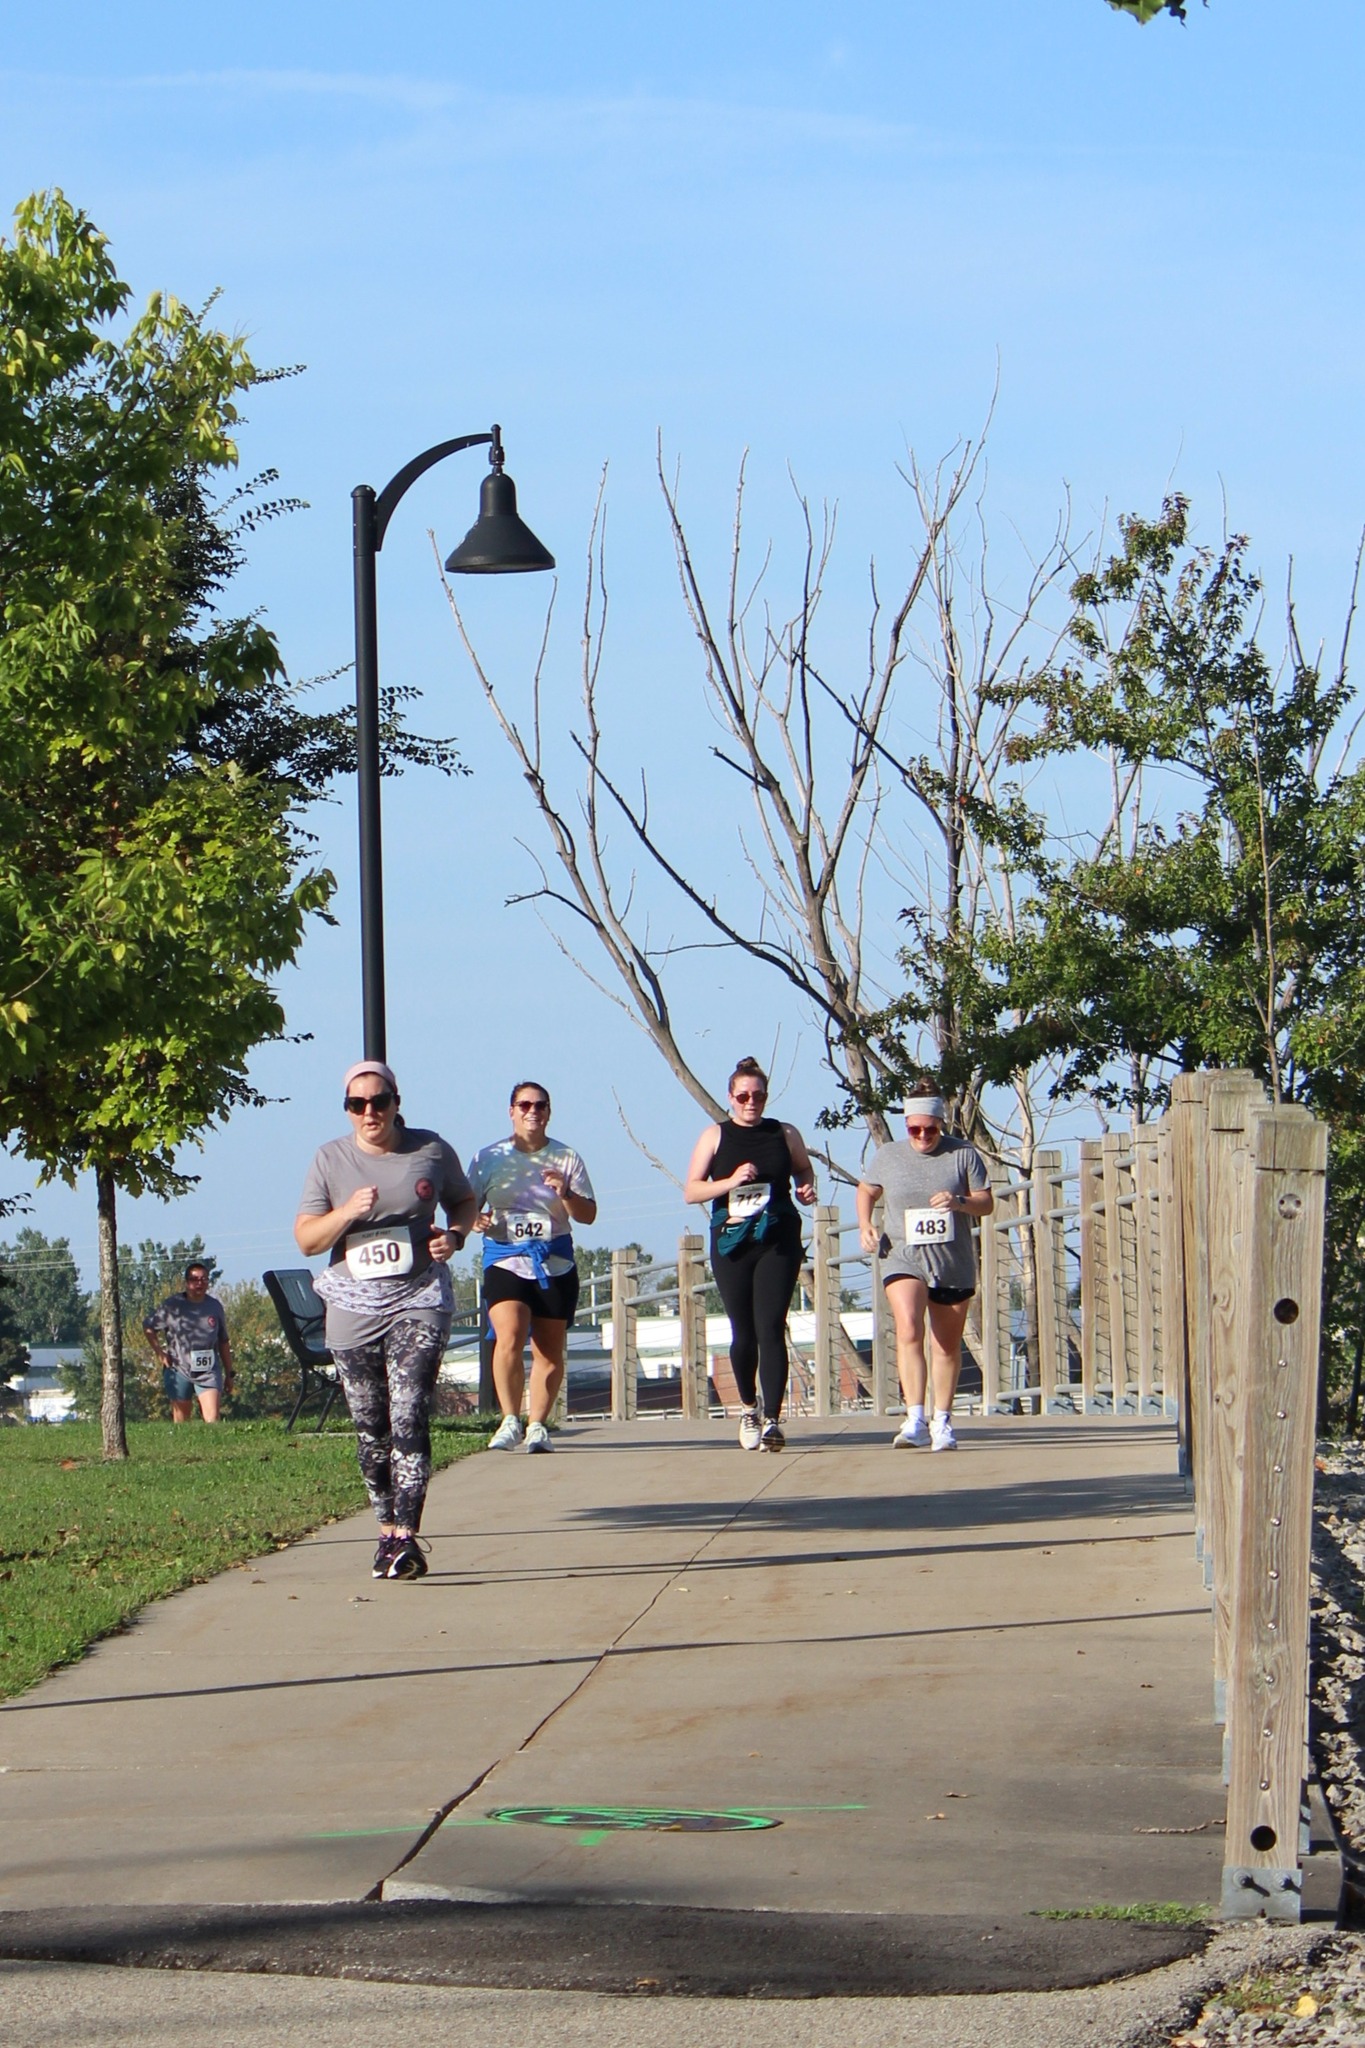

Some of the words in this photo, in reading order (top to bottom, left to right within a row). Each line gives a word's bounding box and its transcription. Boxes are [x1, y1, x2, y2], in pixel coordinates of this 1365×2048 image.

[736, 1193, 762, 1207] 712
[515, 1222, 543, 1238] 642
[915, 1219, 946, 1235] 483
[359, 1242, 400, 1265] 450
[196, 1356, 211, 1366] 561
